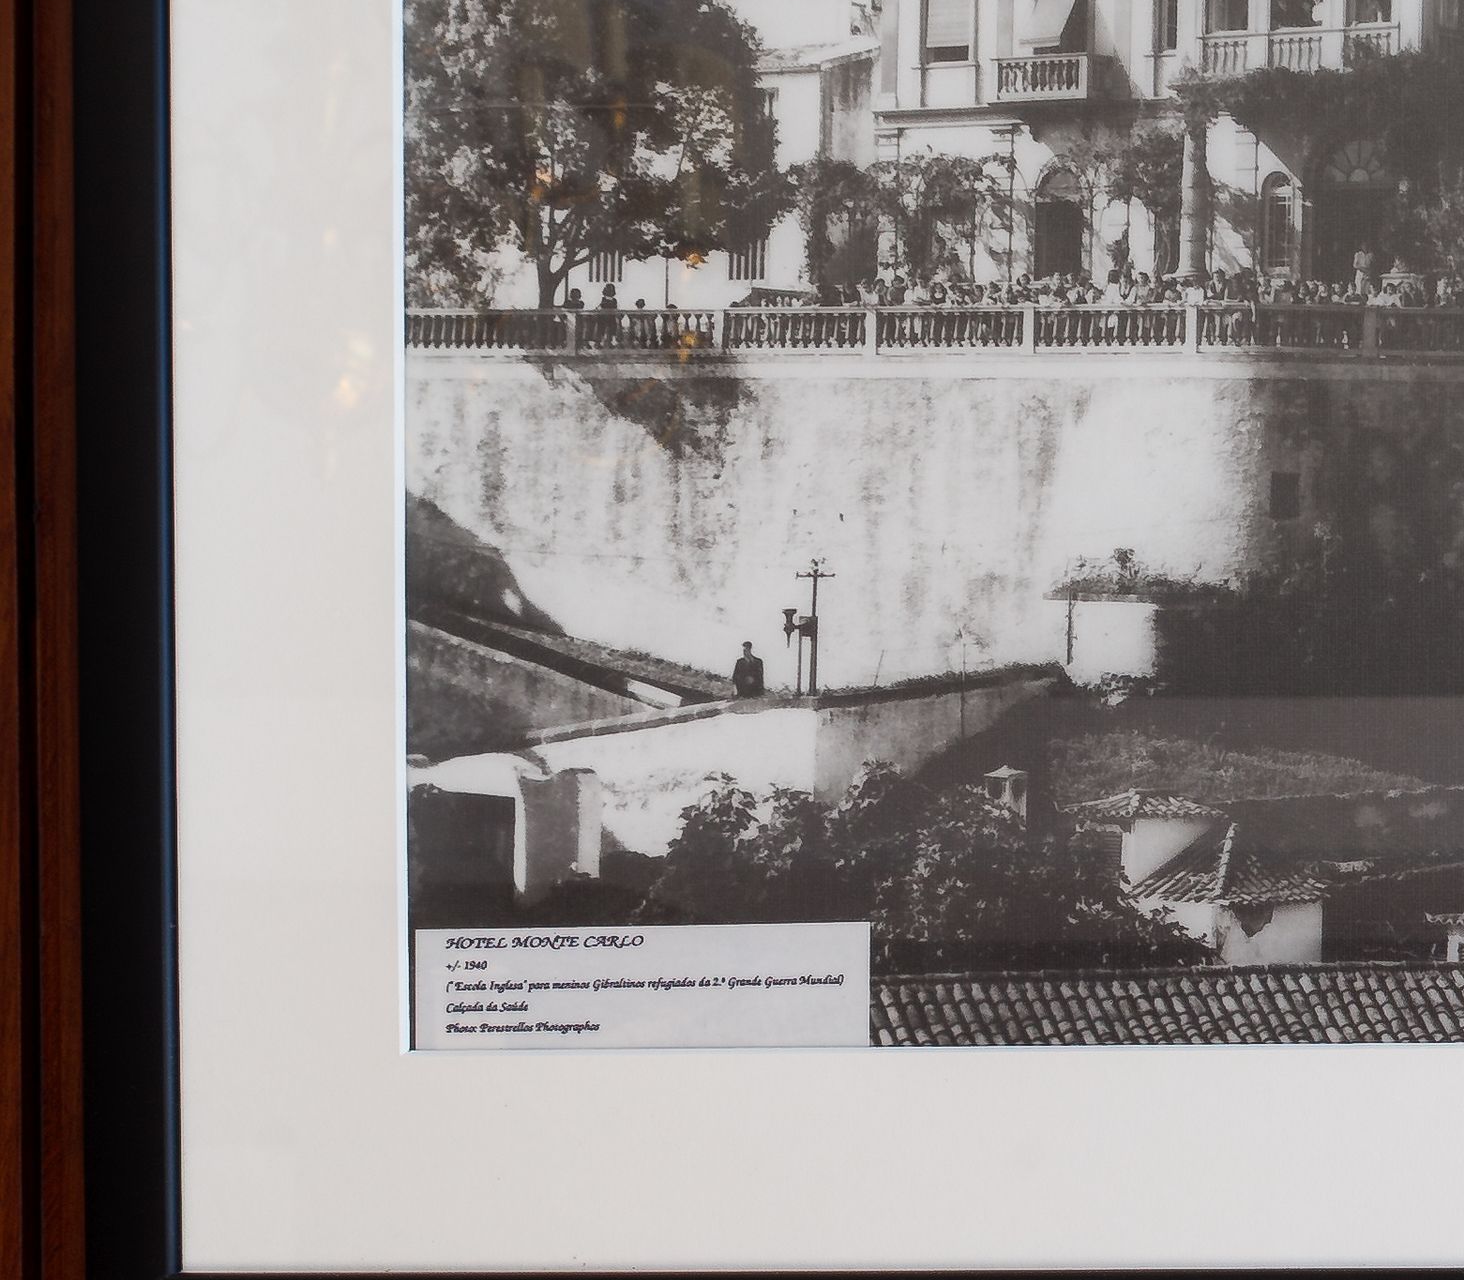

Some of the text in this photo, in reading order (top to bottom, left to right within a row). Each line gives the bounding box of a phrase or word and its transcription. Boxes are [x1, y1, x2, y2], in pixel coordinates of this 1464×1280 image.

[445, 934, 645, 950] HOTEL MONTE CARLO
[464, 960, 488, 971] 1940
[528, 982, 550, 993] para
[551, 979, 591, 990] meninos
[592, 977, 647, 992] Gibraltinos
[647, 976, 697, 991] refugiados
[699, 977, 710, 987] da
[727, 975, 763, 990] Grande
[764, 975, 798, 989] Guerra
[798, 973, 845, 987] Mundial)
[445, 1000, 529, 1015] Calçada da Saúde
[534, 1020, 601, 1035] Photographos
